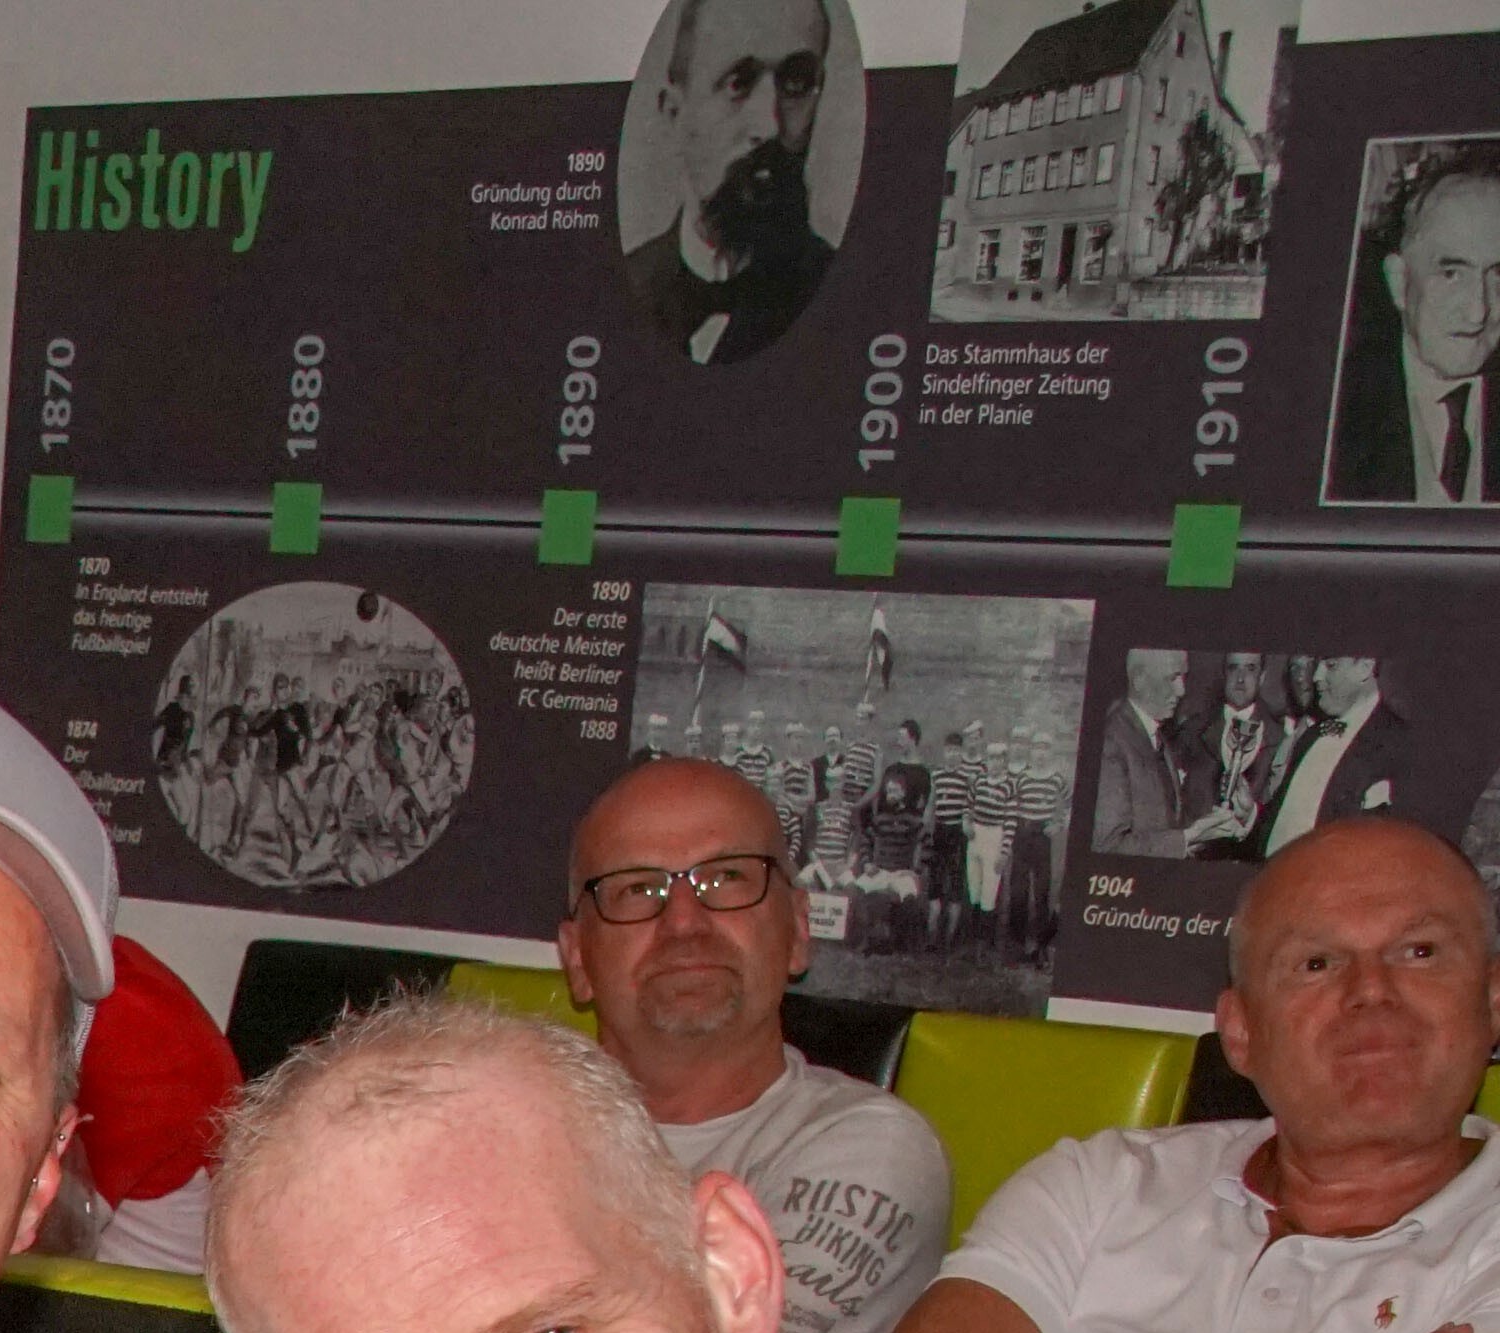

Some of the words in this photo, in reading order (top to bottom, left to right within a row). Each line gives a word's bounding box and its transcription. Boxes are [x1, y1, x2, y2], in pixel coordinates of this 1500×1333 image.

[567, 152, 605, 173] 1890
[33, 129, 272, 253] History
[472, 184, 551, 207] Gründung
[556, 181, 602, 202] durch
[490, 211, 547, 232] Konrad
[552, 208, 600, 230] Röhm
[926, 343, 958, 365] Das
[964, 342, 1071, 365] Stammhaus
[1076, 341, 1108, 365] der
[40, 339, 76, 453] 1870
[287, 335, 326, 459] 1880
[922, 374, 1033, 399] Sindelfinger
[1038, 373, 1110, 400] Zeitung
[558, 336, 602, 466] 1890
[858, 333, 907, 472] 1900
[1193, 337, 1249, 477] 1910
[919, 404, 936, 425] in
[941, 403, 972, 425] der
[978, 403, 1033, 426] Planie
[78, 557, 111, 576] 1870
[93, 584, 148, 607] England
[592, 581, 631, 600] 1890
[553, 607, 582, 627] Der
[587, 611, 627, 629] erste
[490, 631, 560, 654] deutsche
[564, 635, 625, 656] Meister
[514, 660, 555, 682] heißt
[559, 663, 623, 685] Berliner
[518, 688, 540, 708] FC
[542, 689, 618, 712] Germania
[580, 720, 617, 740] 1888
[1088, 875, 1134, 897] 1904
[1083, 905, 1180, 937] Gründung
[1186, 914, 1220, 936] der
[795, 1214, 885, 1287] HIKING
